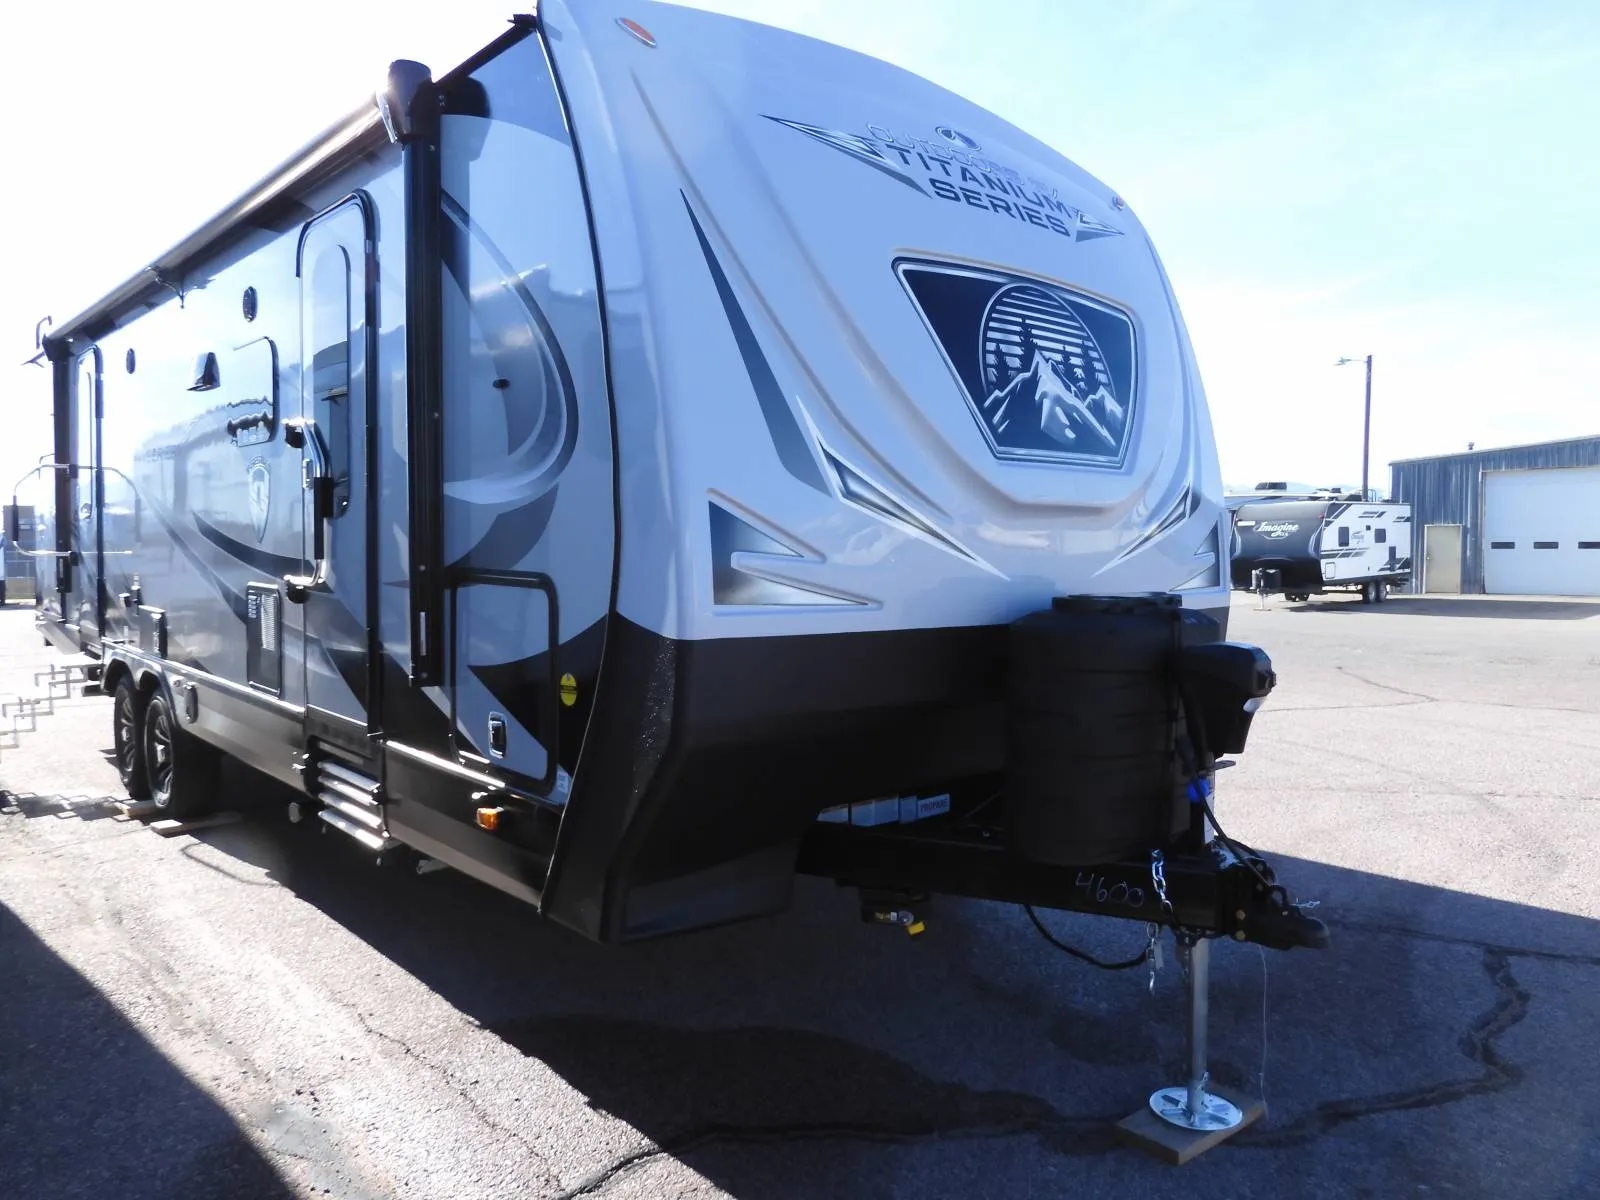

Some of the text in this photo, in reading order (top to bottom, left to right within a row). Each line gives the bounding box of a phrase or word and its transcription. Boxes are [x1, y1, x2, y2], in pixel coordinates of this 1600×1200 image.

[885, 144, 1072, 218] TITANIUM
[929, 178, 1070, 237] SERIES
[1256, 521, 1299, 537] Imagine
[1075, 871, 1145, 907] 4600
